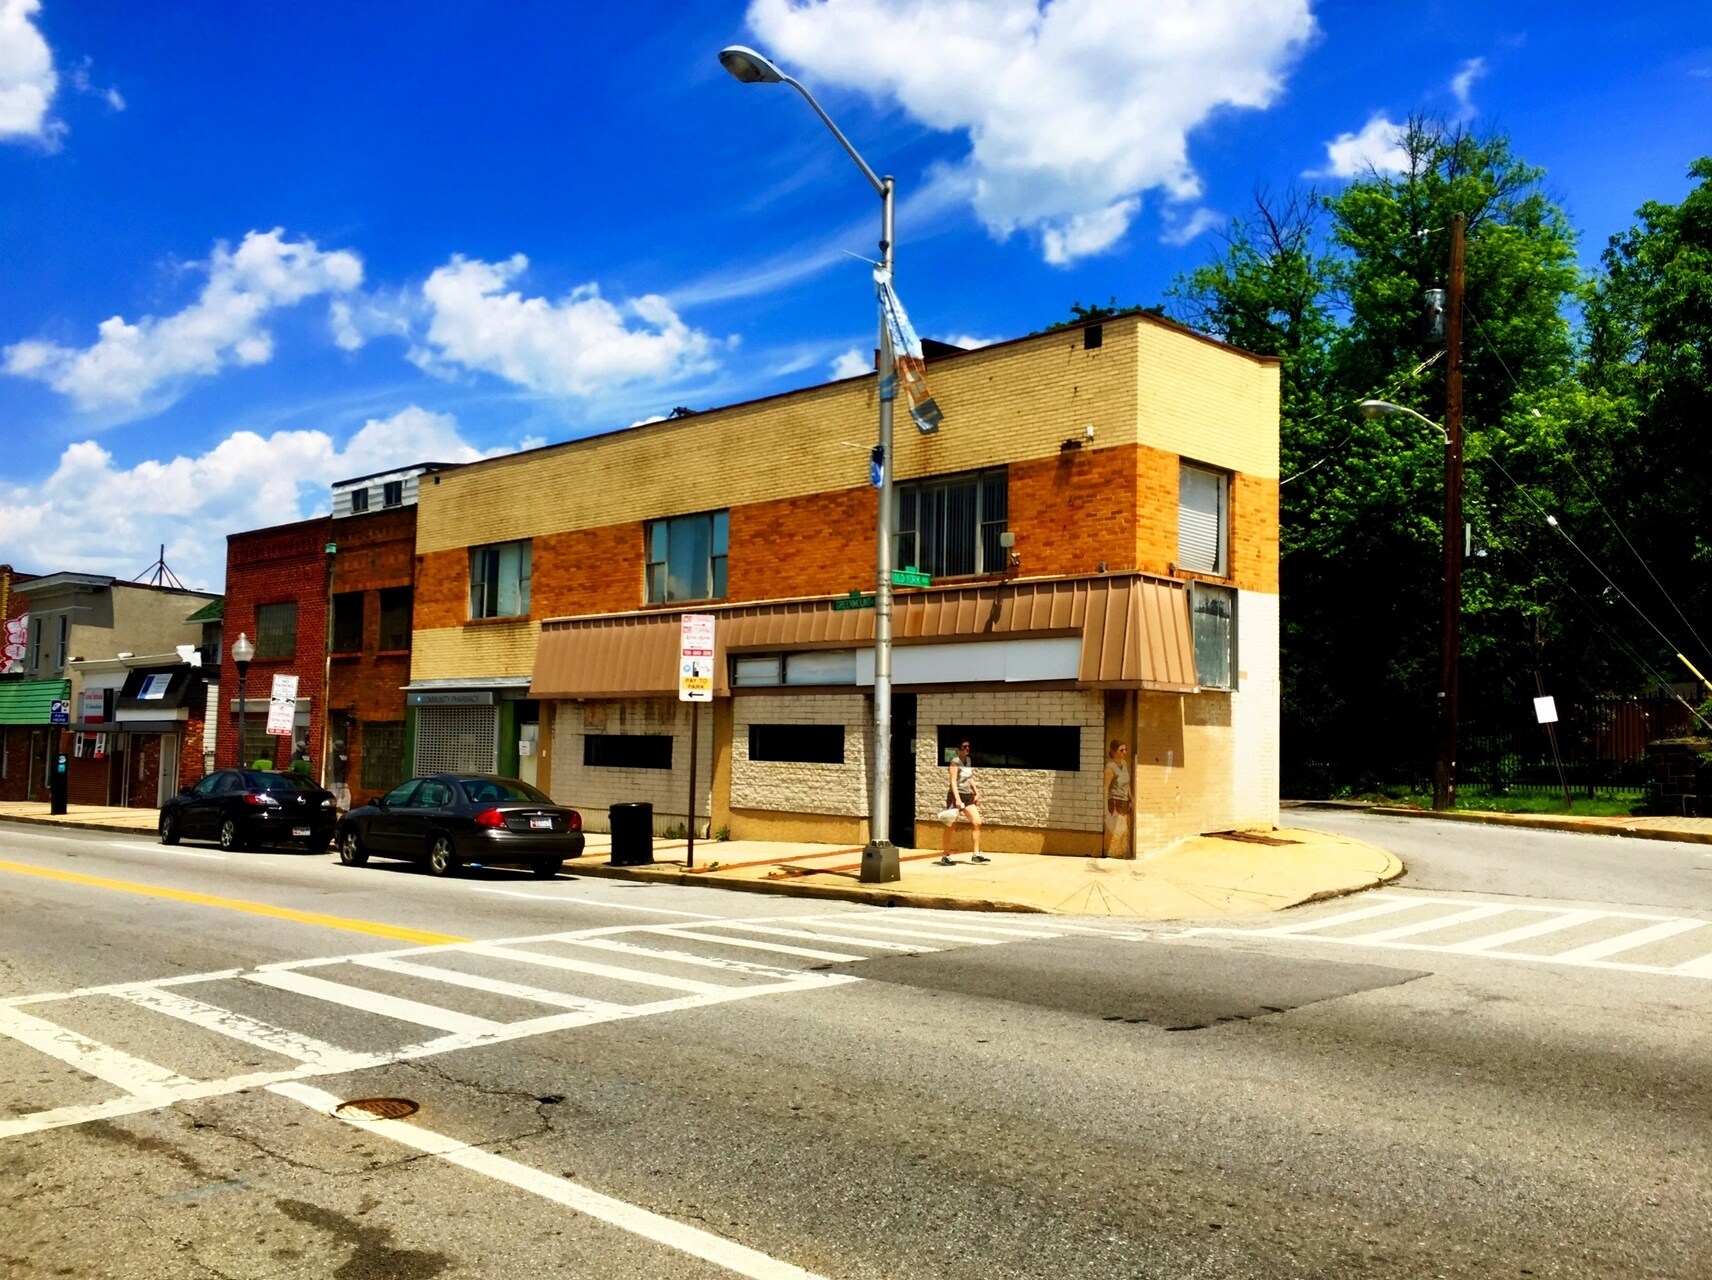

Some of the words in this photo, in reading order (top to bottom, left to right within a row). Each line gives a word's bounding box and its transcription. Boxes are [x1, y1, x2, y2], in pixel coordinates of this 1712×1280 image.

[893, 572, 905, 583] OLD
[906, 574, 921, 585] YORK
[836, 598, 871, 609] GREENMOUNT
[451, 694, 480, 703] PHARMACY
